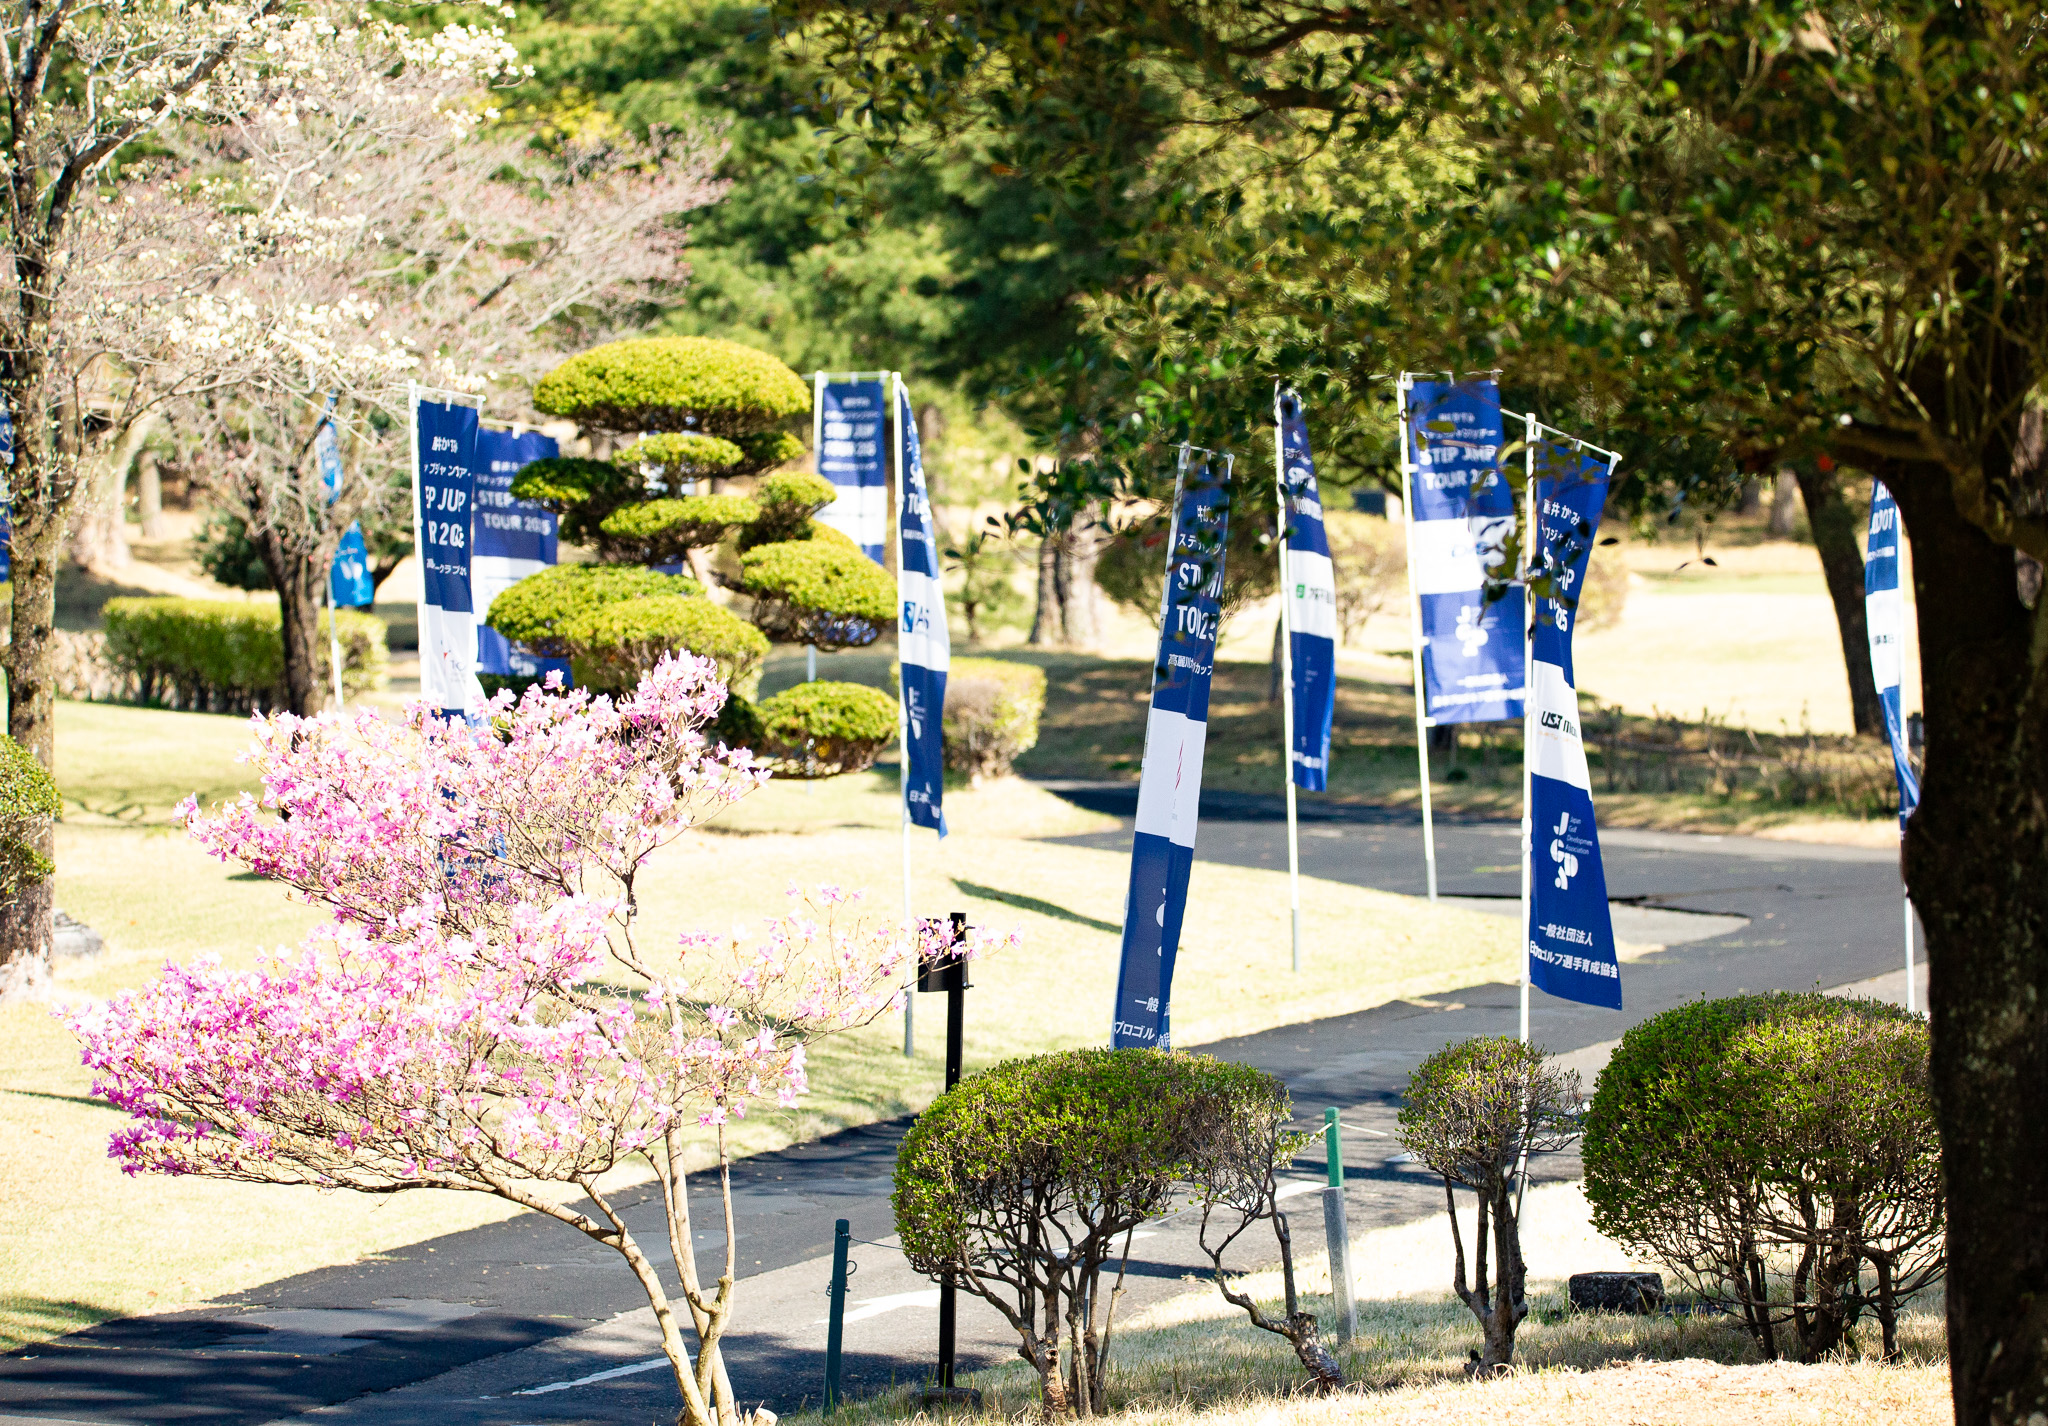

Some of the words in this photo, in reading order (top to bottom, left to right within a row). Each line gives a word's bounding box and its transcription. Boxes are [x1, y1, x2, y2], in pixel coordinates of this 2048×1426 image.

[1422, 469, 1467, 491] TOUR
[482, 513, 522, 530] TOUR
[1565, 844, 1590, 855] Association
[1538, 922, 1593, 947] 一般社団法人
